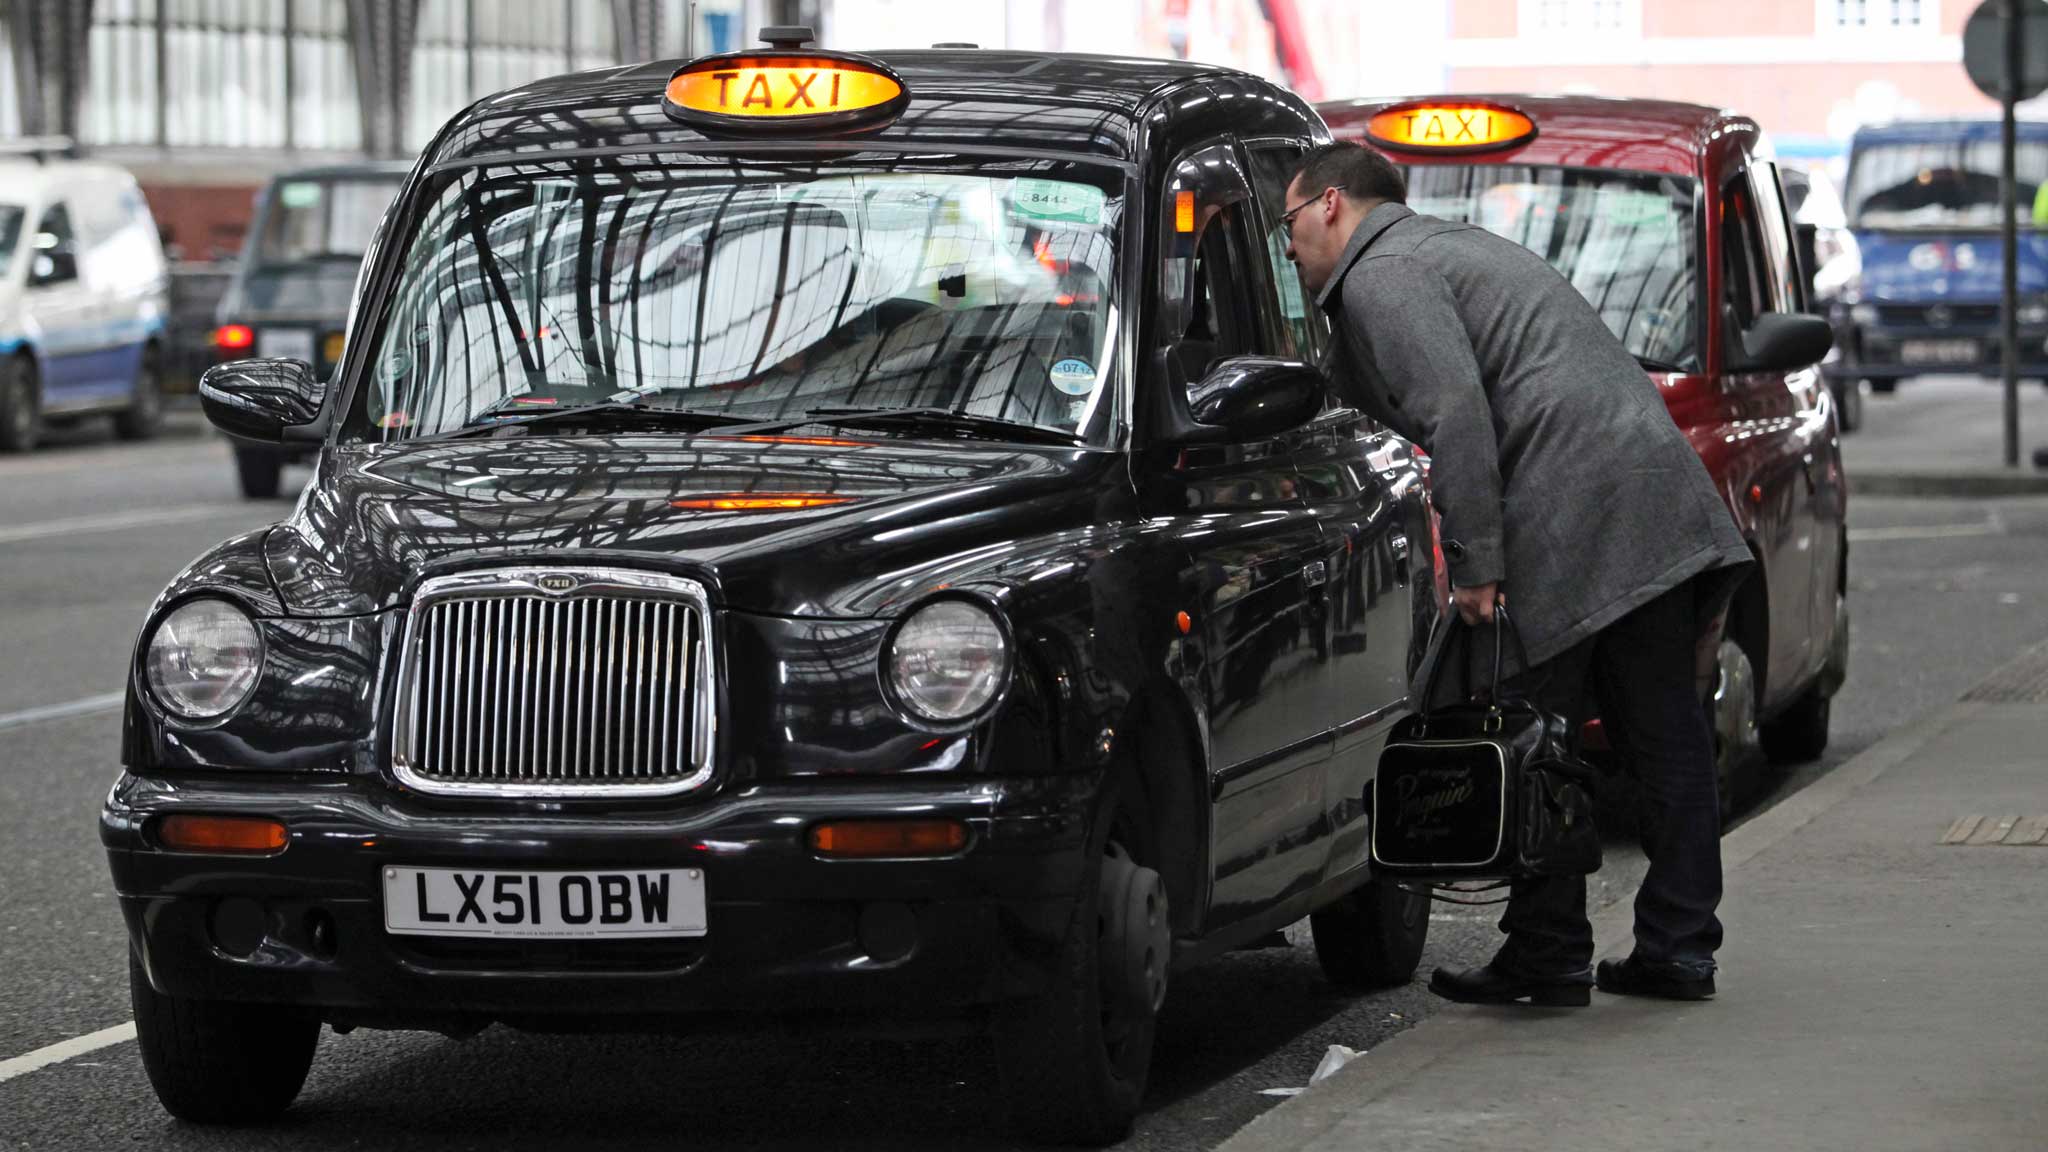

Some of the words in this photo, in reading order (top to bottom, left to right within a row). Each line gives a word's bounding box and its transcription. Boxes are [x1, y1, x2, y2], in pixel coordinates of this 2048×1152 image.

[713, 72, 840, 109] TAXI
[1402, 114, 1492, 139] TAXI
[1063, 363, 1078, 373] 07
[416, 872, 541, 925] LX51
[559, 873, 670, 925] OBW
